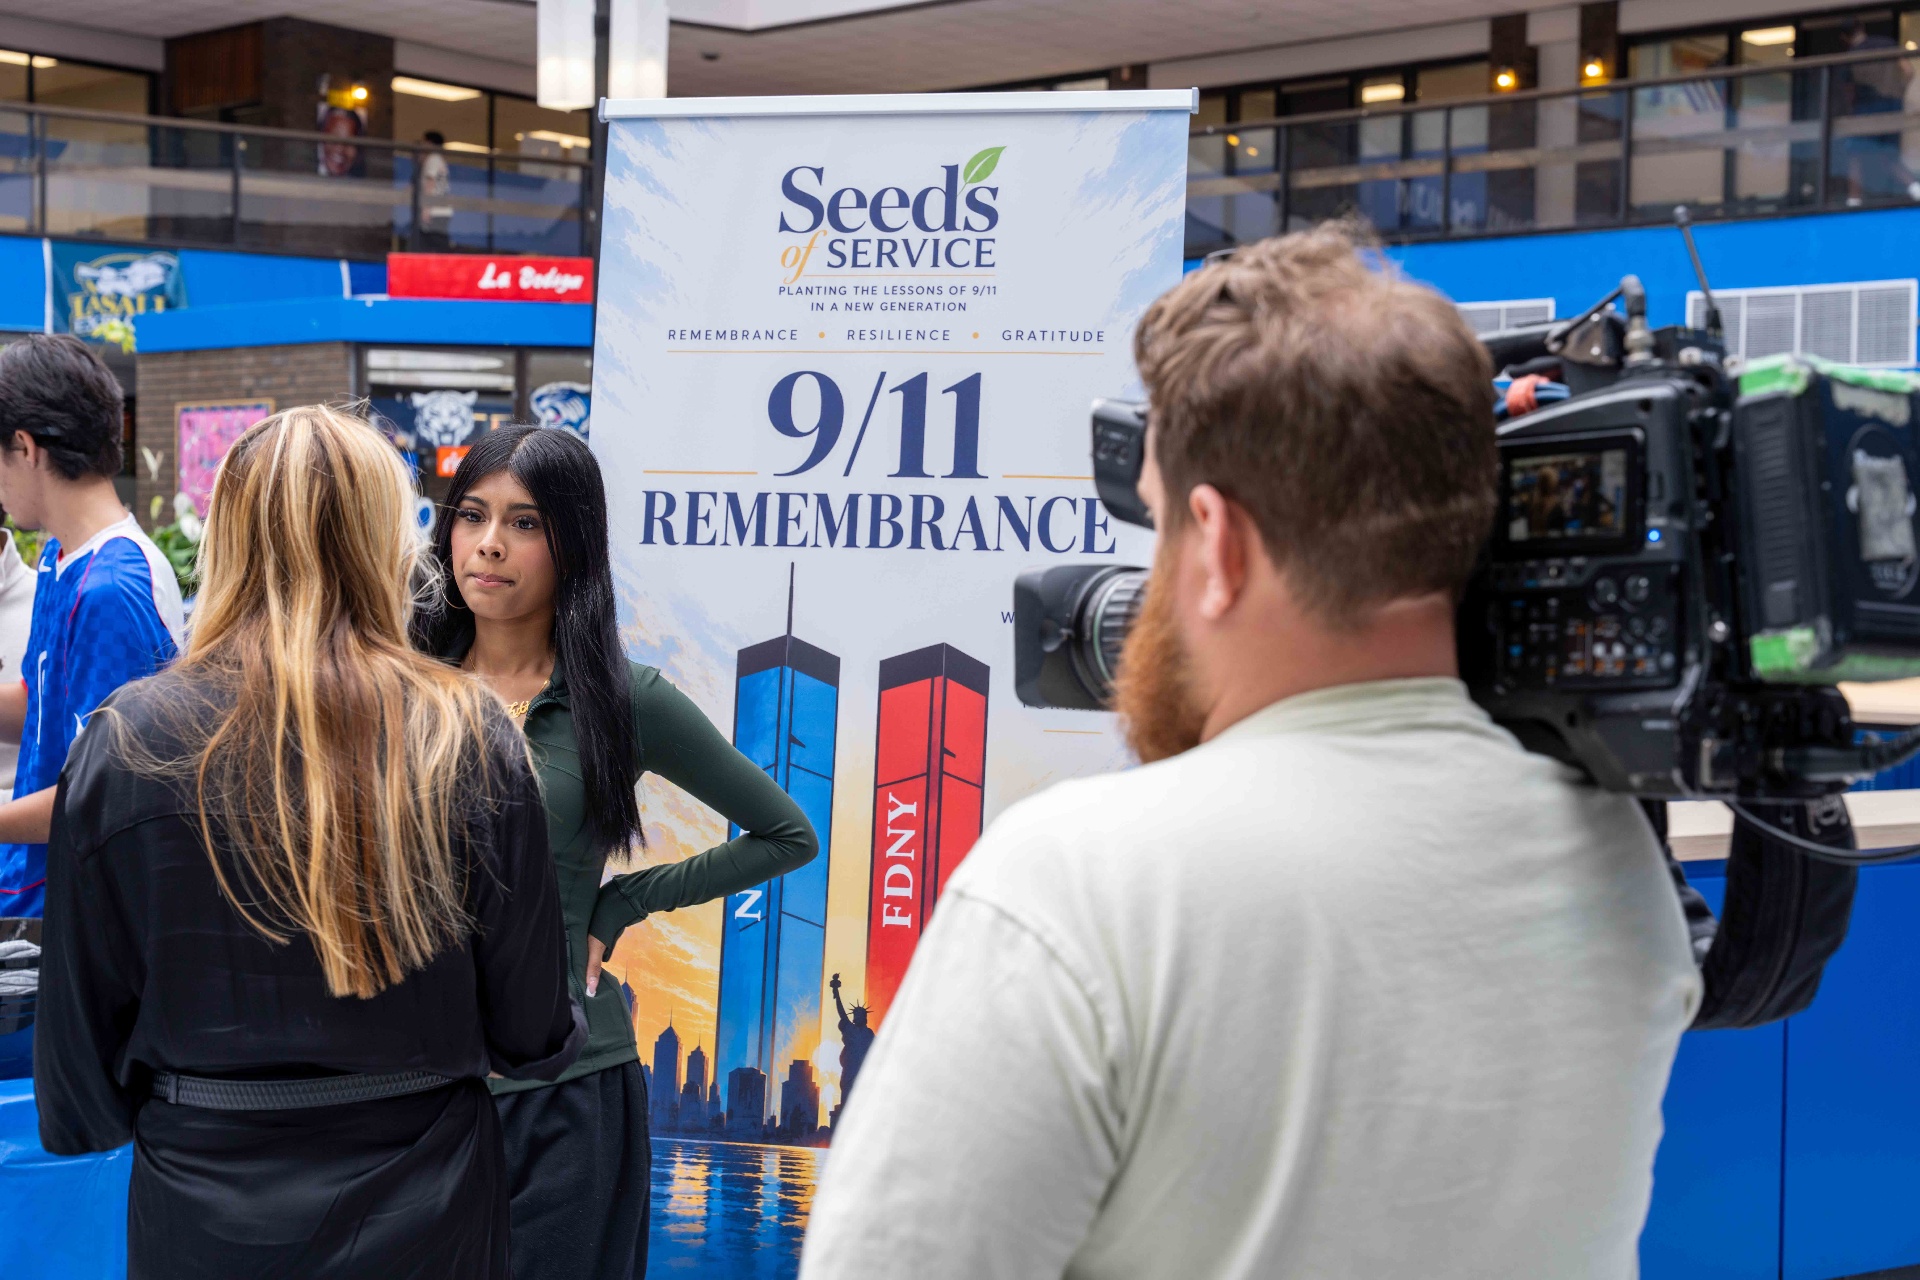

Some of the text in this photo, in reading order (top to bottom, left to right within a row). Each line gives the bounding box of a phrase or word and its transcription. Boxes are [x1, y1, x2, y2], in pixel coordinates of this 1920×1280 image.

[778, 163, 999, 234] Seeds
[477, 261, 512, 290] La
[780, 229, 996, 285] of SERVICE
[778, 285, 997, 297] PLANTING THE LESSONS OF 9/11
[810, 301, 967, 312] IN A NEW GENERATION
[668, 329, 1105, 342] REMEMBRANCE RESILIENCE GRATITUDE
[767, 370, 989, 479] 9/11
[639, 490, 1117, 554] REMEMBRANCE
[882, 792, 918, 928] FDNY
